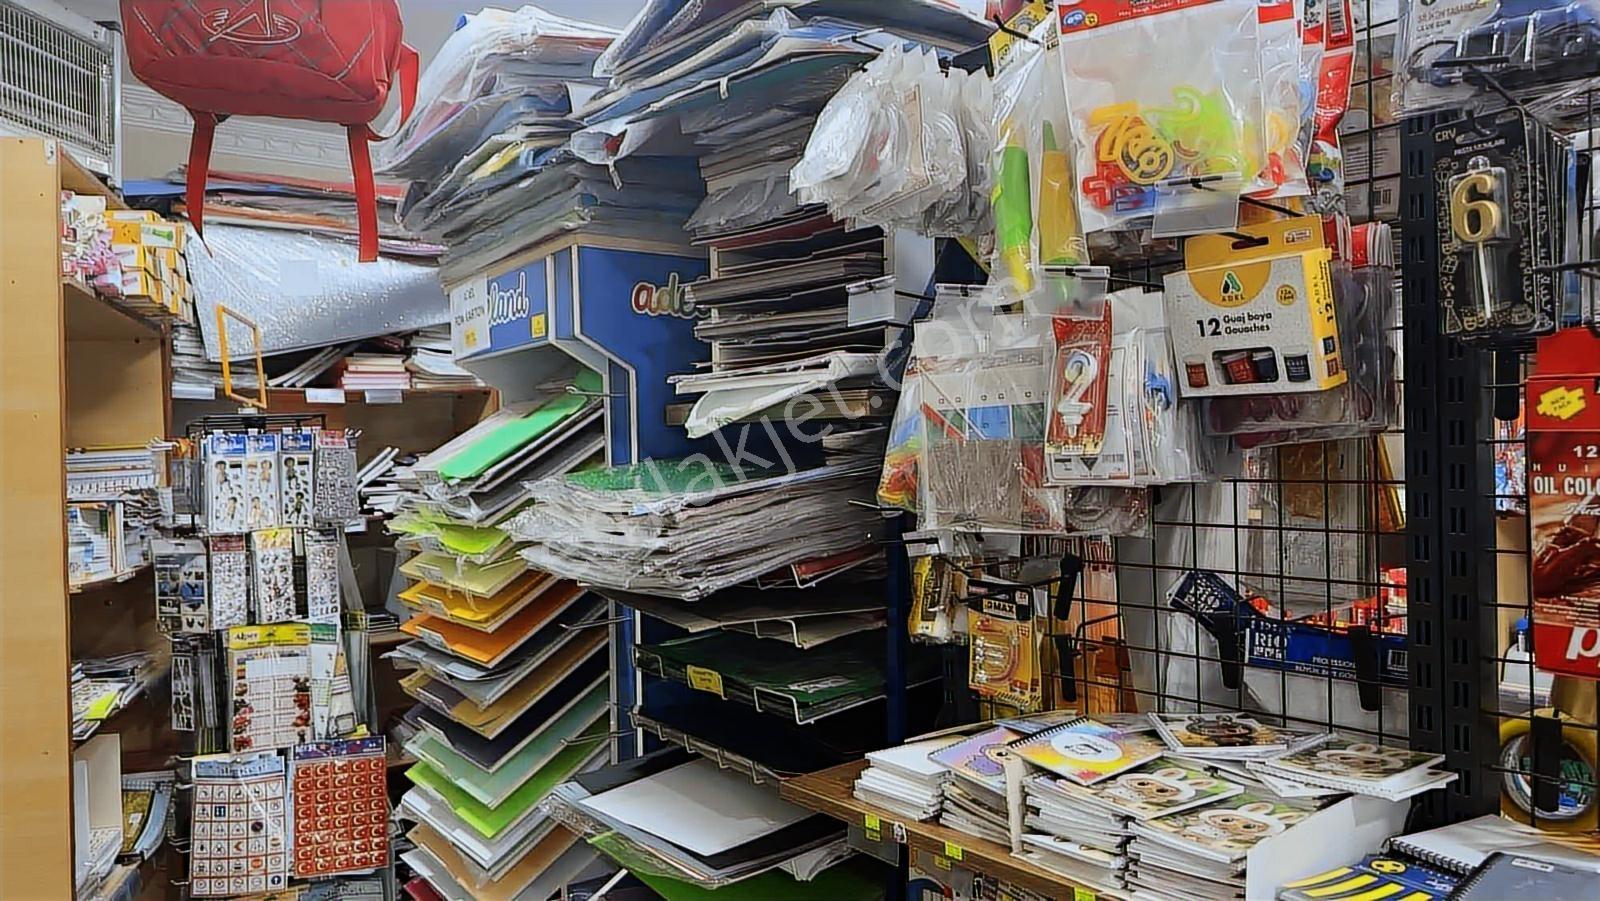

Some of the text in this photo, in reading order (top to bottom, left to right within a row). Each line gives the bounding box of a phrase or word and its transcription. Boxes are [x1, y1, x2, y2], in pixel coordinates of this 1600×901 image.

[1435, 128, 1457, 142] CRV
[1453, 173, 1502, 242] 6
[486, 271, 530, 326] land
[631, 272, 703, 319] ade
[1221, 294, 1246, 302] ADEL
[1196, 311, 1272, 338] 12 Guaj boya
[1224, 322, 1270, 335] Gouaches
[1573, 445, 1598, 458] 12
[1533, 476, 1559, 495] OIL
